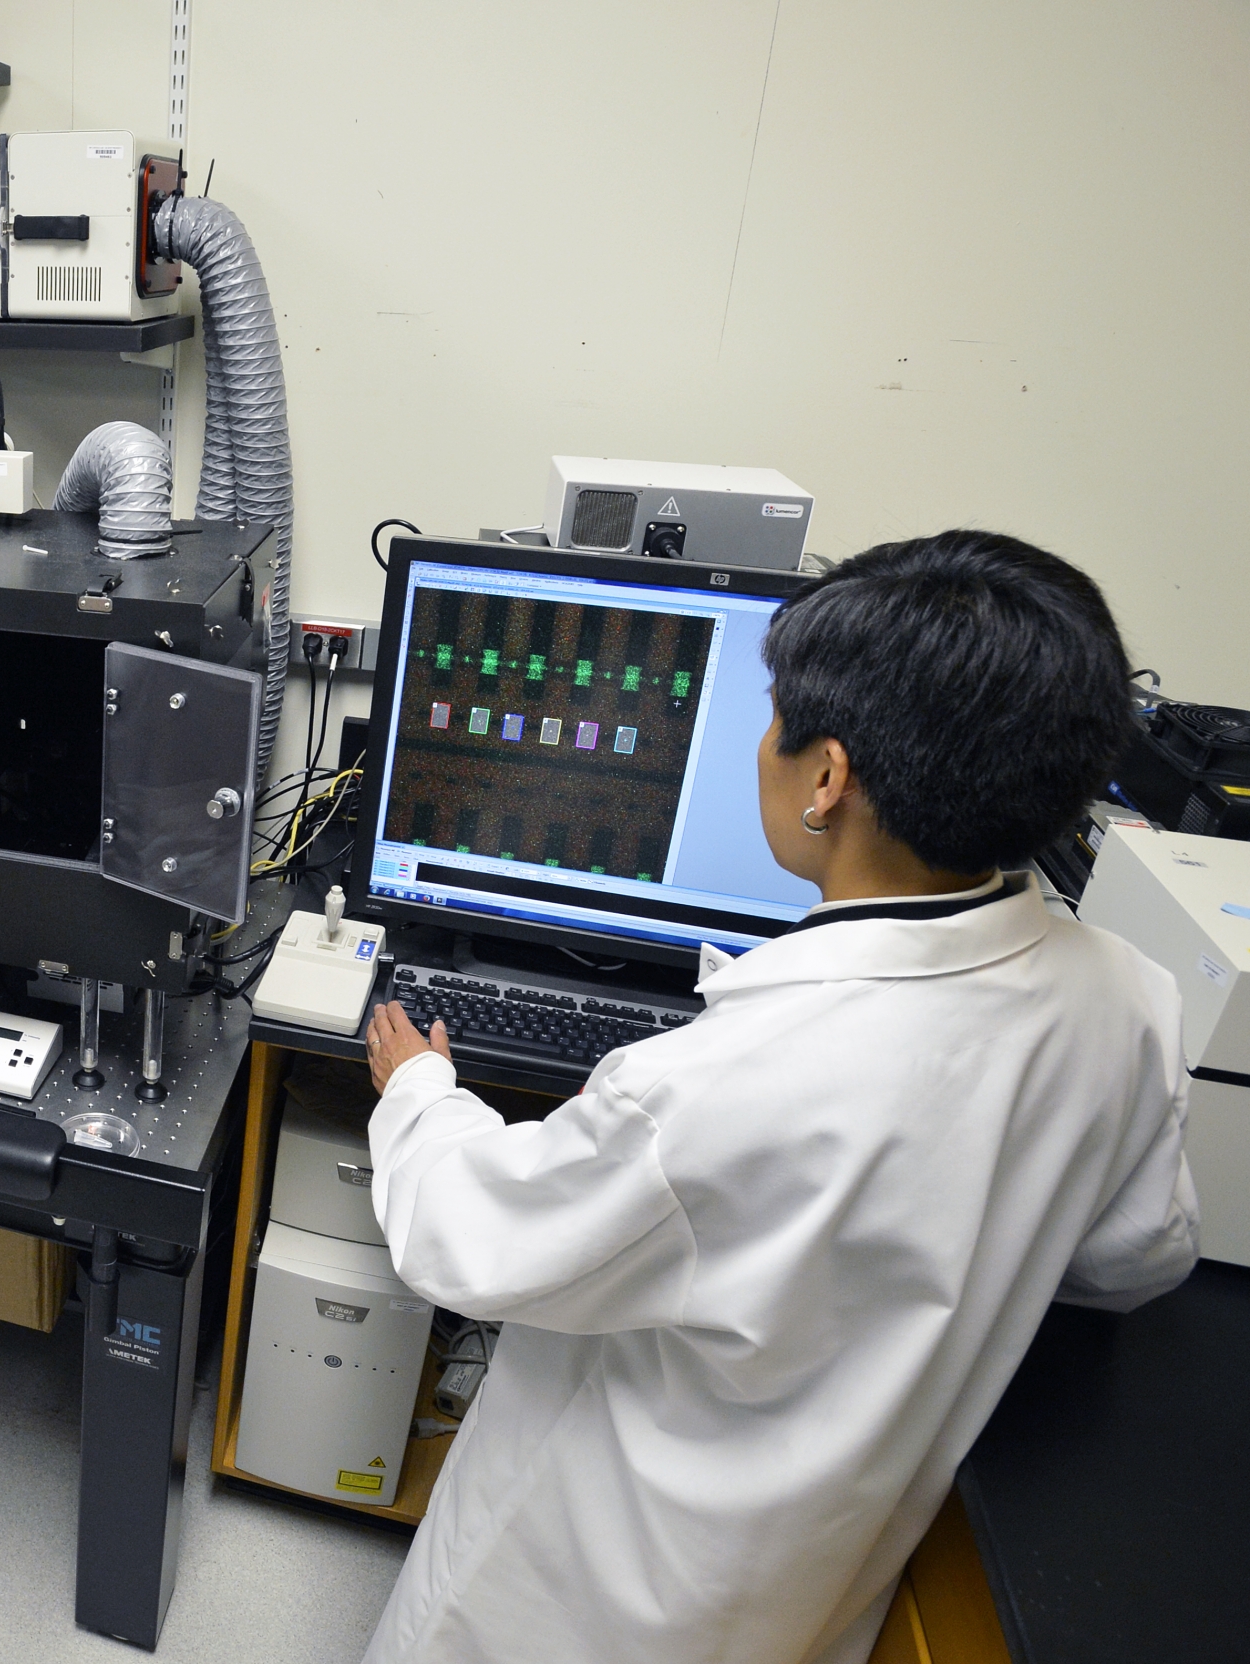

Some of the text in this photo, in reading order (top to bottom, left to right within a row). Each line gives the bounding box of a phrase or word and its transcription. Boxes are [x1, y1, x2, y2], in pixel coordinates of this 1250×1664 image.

[350, 1170, 371, 1179] Niko
[329, 1305, 355, 1315] Nikon
[116, 1318, 160, 1345] MC
[103, 1336, 160, 1355] Gimbal Piston
